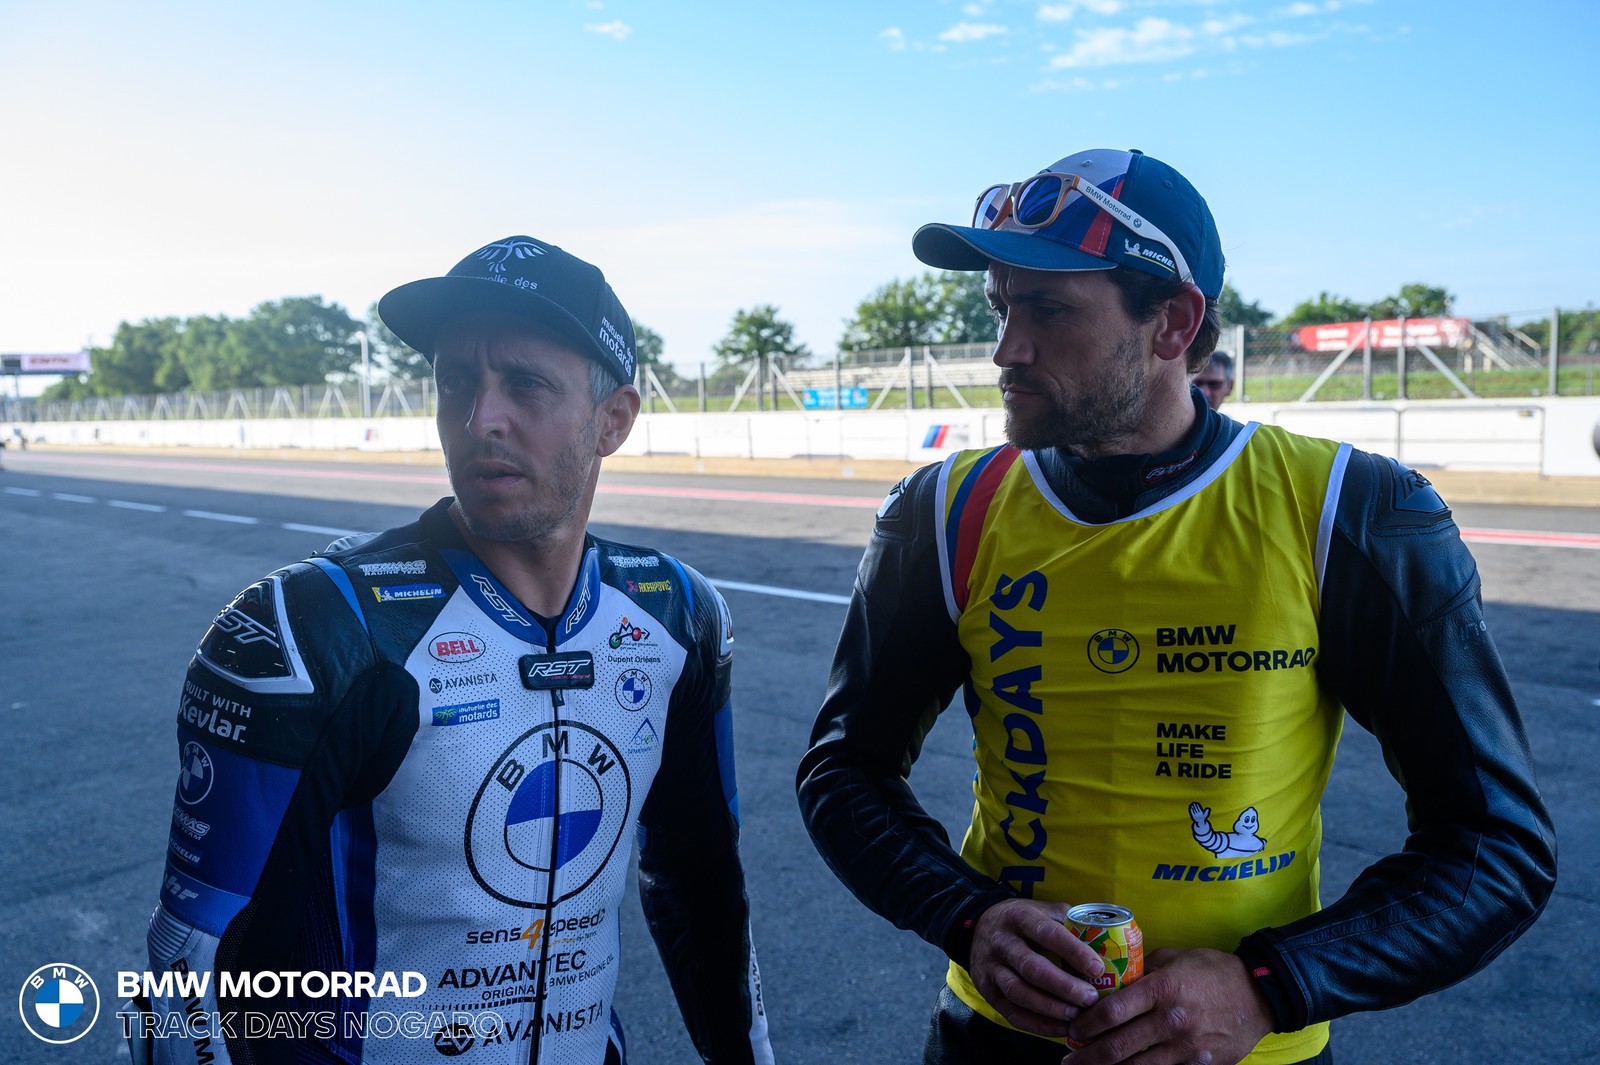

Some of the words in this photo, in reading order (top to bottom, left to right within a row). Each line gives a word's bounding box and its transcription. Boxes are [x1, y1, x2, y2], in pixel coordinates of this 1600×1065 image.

[1085, 185, 1104, 204] BMW
[1102, 199, 1132, 221] Motorrad
[599, 327, 632, 377] motards
[394, 587, 442, 598] MICHELIN
[470, 573, 532, 627] RST
[566, 572, 591, 634] RST
[212, 603, 280, 649] ST
[1094, 630, 1131, 643] BMW
[1156, 624, 1236, 647] BMW
[436, 639, 480, 657] BELL
[1156, 647, 1316, 674] MOTORRAD
[444, 672, 498, 690] AVANISTA
[527, 659, 591, 678] RST
[186, 680, 210, 702] BUILT
[212, 694, 252, 718] WITH
[458, 708, 498, 723] motards
[989, 570, 1049, 899] ACKDAYS
[1156, 722, 1226, 741] MAKE
[496, 731, 615, 792] BMW
[1156, 743, 1204, 759] LIFE
[1155, 761, 1172, 777] A
[1178, 763, 1232, 779] RIDE
[1152, 850, 1296, 882] MICHELIN
